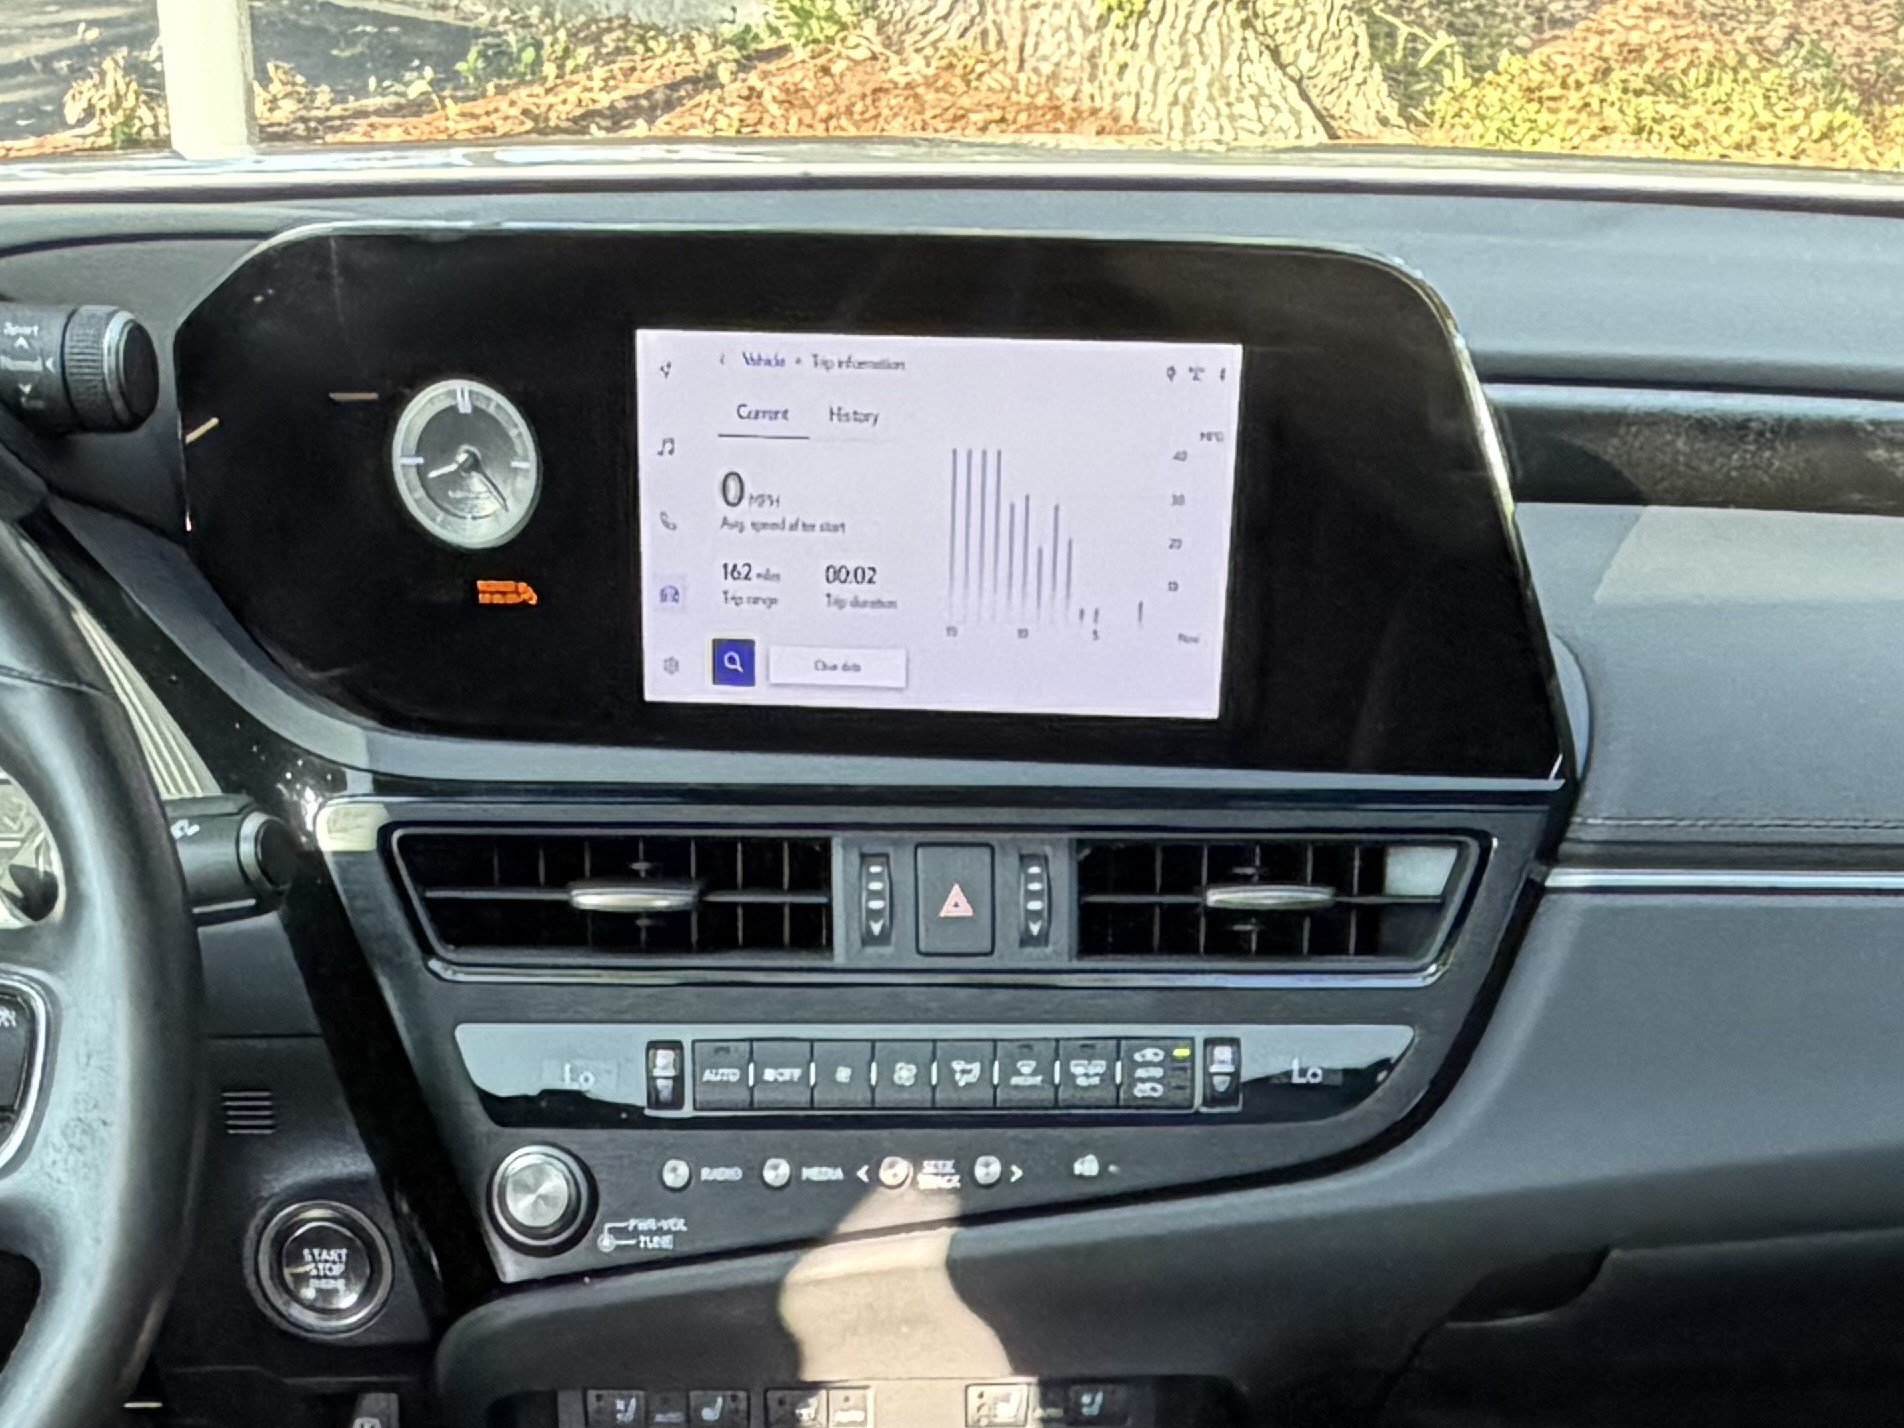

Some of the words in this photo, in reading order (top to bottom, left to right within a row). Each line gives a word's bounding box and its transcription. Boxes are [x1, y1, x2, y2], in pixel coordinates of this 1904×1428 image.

[736, 403, 790, 421] Current
[829, 406, 880, 427] History
[721, 471, 745, 508] 0
[722, 563, 753, 581] 162
